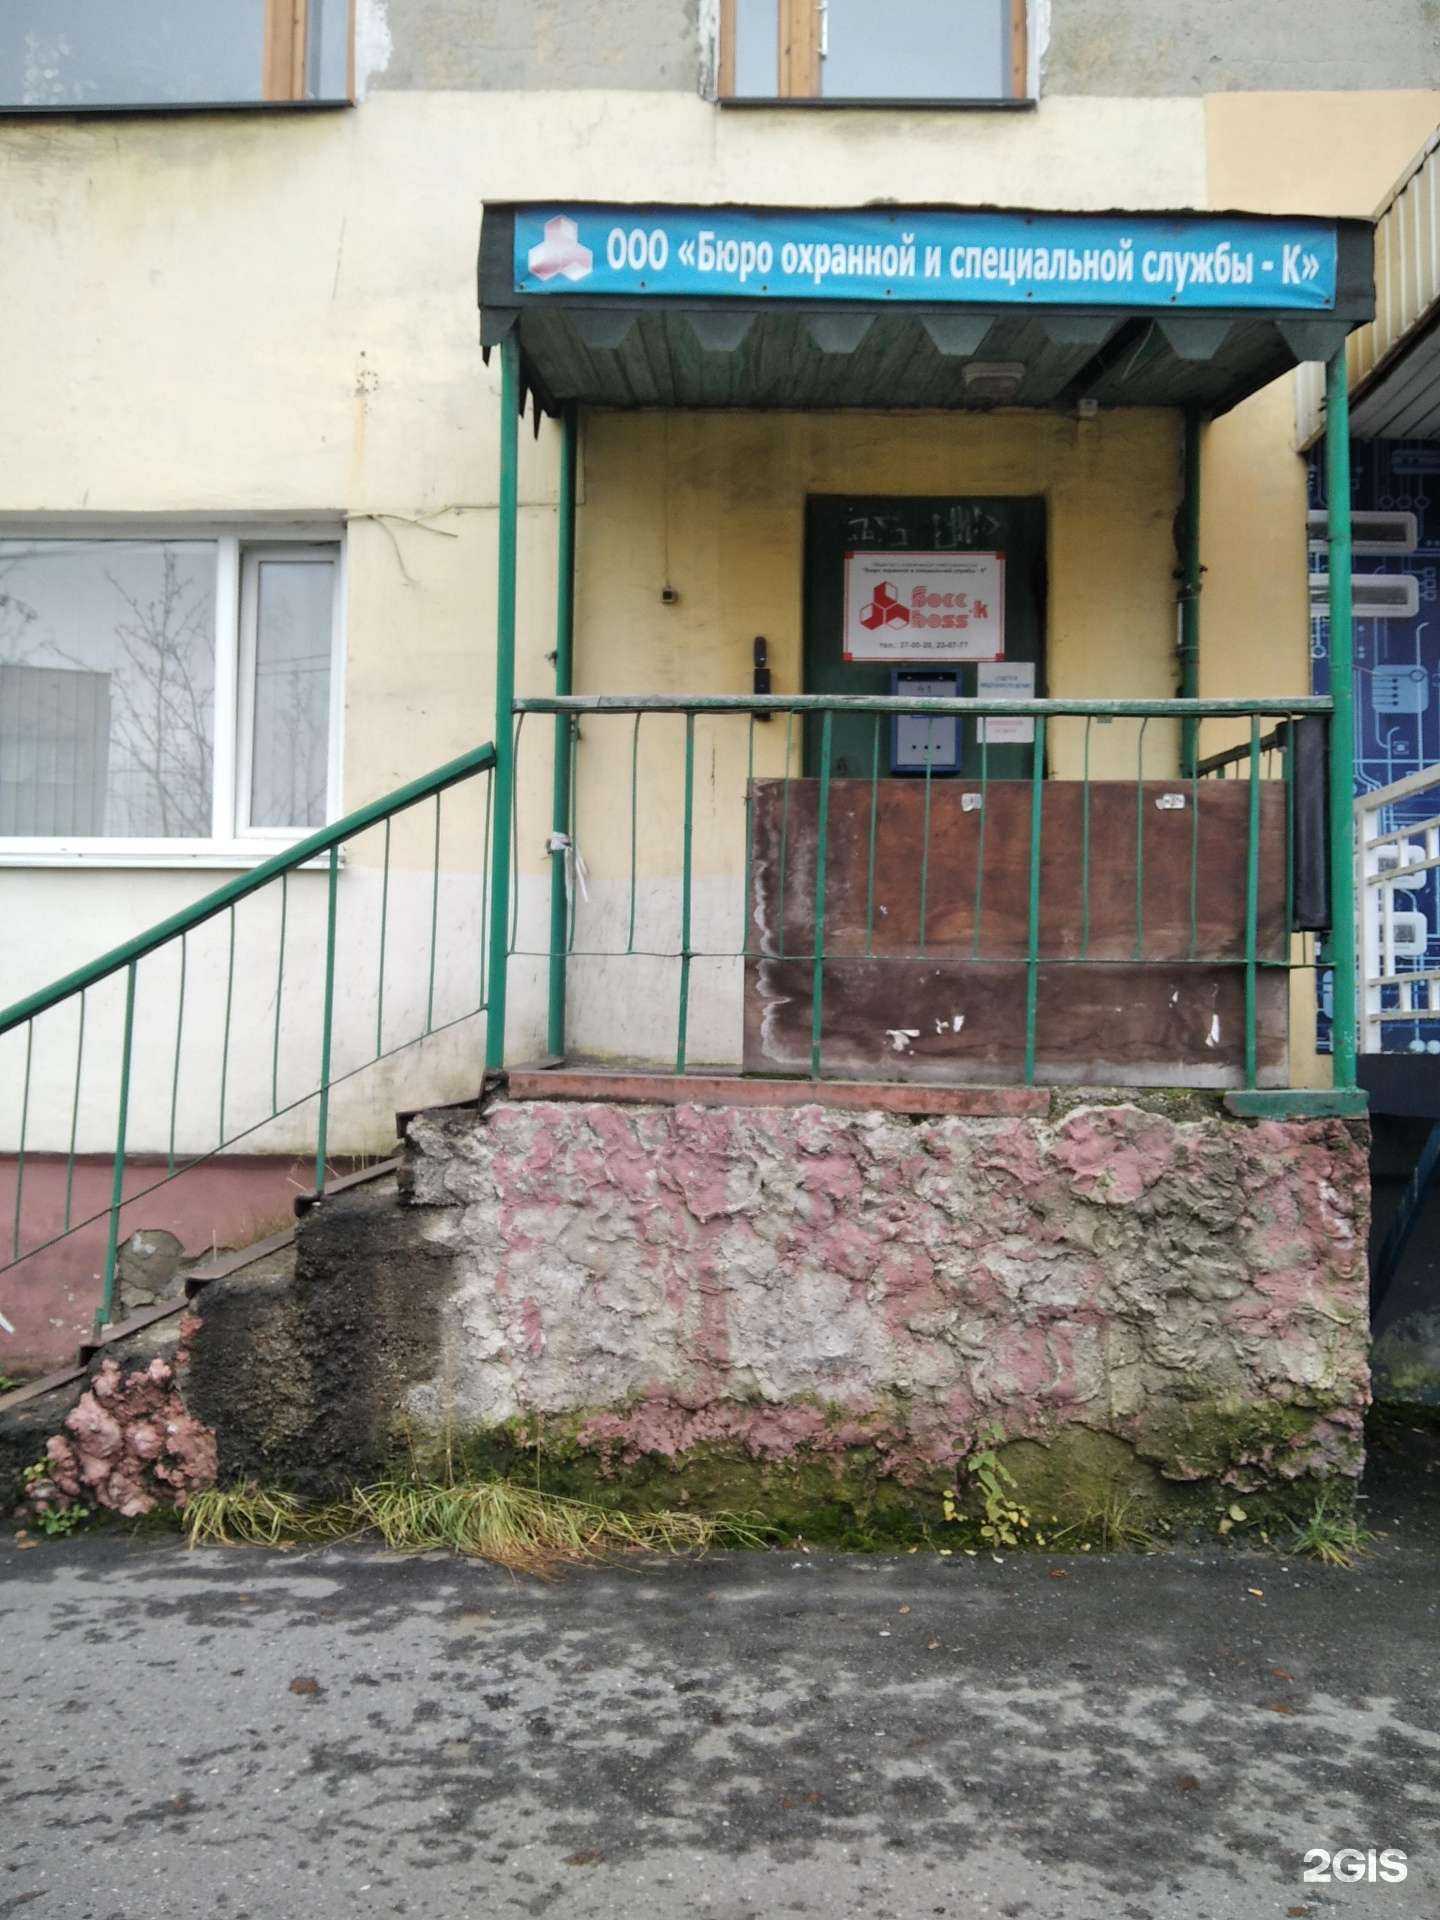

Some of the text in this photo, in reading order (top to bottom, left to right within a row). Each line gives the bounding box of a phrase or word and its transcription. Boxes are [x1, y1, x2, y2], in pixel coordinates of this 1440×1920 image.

[606, 227, 669, 271] ООО
[678, 231, 773, 283] «Бюро
[781, 232, 917, 285] охранной
[924, 247, 942, 277] и
[949, 238, 1133, 285] специальной
[1142, 242, 1253, 293] службы
[1282, 244, 1320, 284] К»
